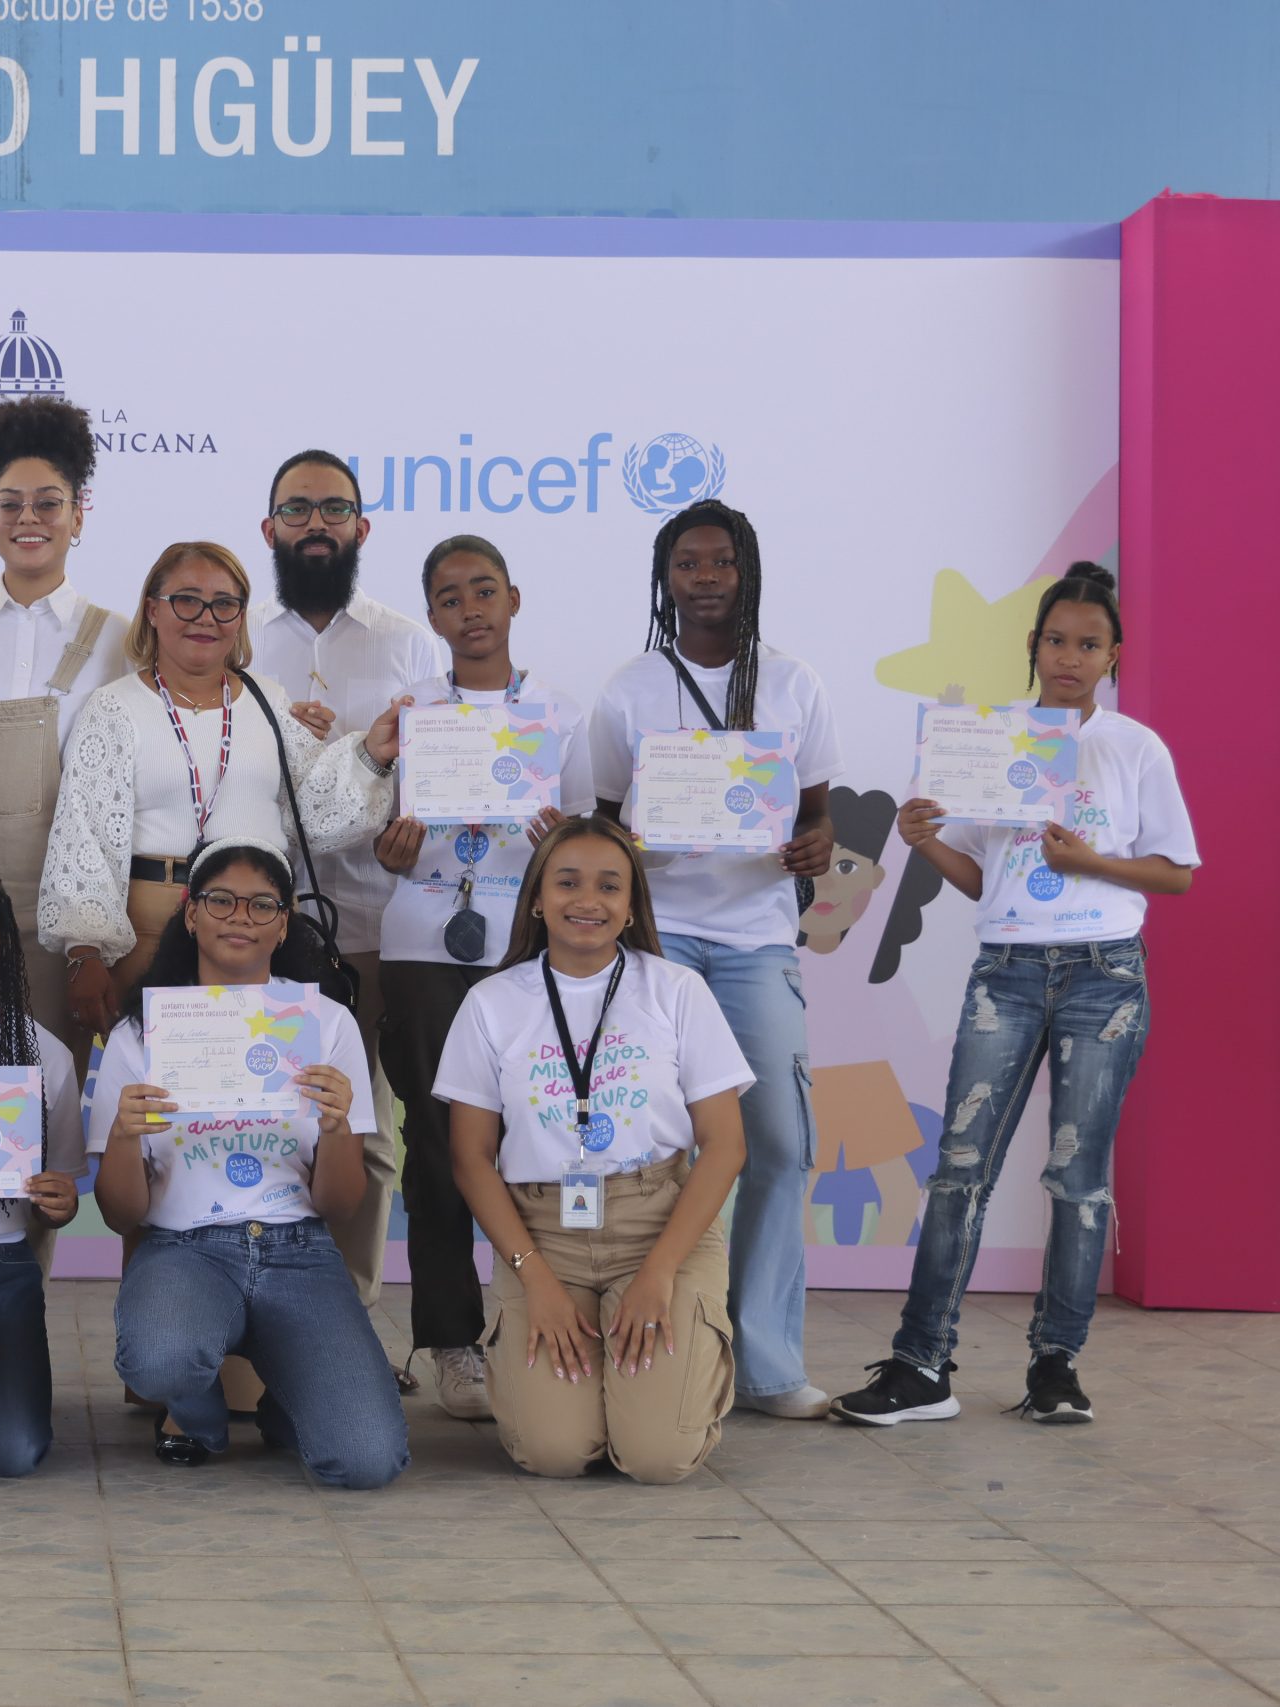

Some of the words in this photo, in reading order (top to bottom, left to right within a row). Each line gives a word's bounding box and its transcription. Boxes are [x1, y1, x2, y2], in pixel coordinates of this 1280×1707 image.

[127, 0, 168, 21] de
[79, 36, 480, 157] HIGÜEY
[102, 409, 128, 423] LA
[95, 433, 218, 453] NICANA
[347, 432, 613, 515] unicef
[476, 874, 508, 888] unicef
[1054, 909, 1089, 921] unicef
[604, 1033, 628, 1047] DE
[593, 1045, 650, 1070] EÑOS,
[606, 1065, 627, 1080] de
[566, 1086, 649, 1119] FTURO
[209, 1132, 299, 1157] FUTURO
[229, 1158, 255, 1168] CLUB
[262, 1184, 291, 1204] unicef
